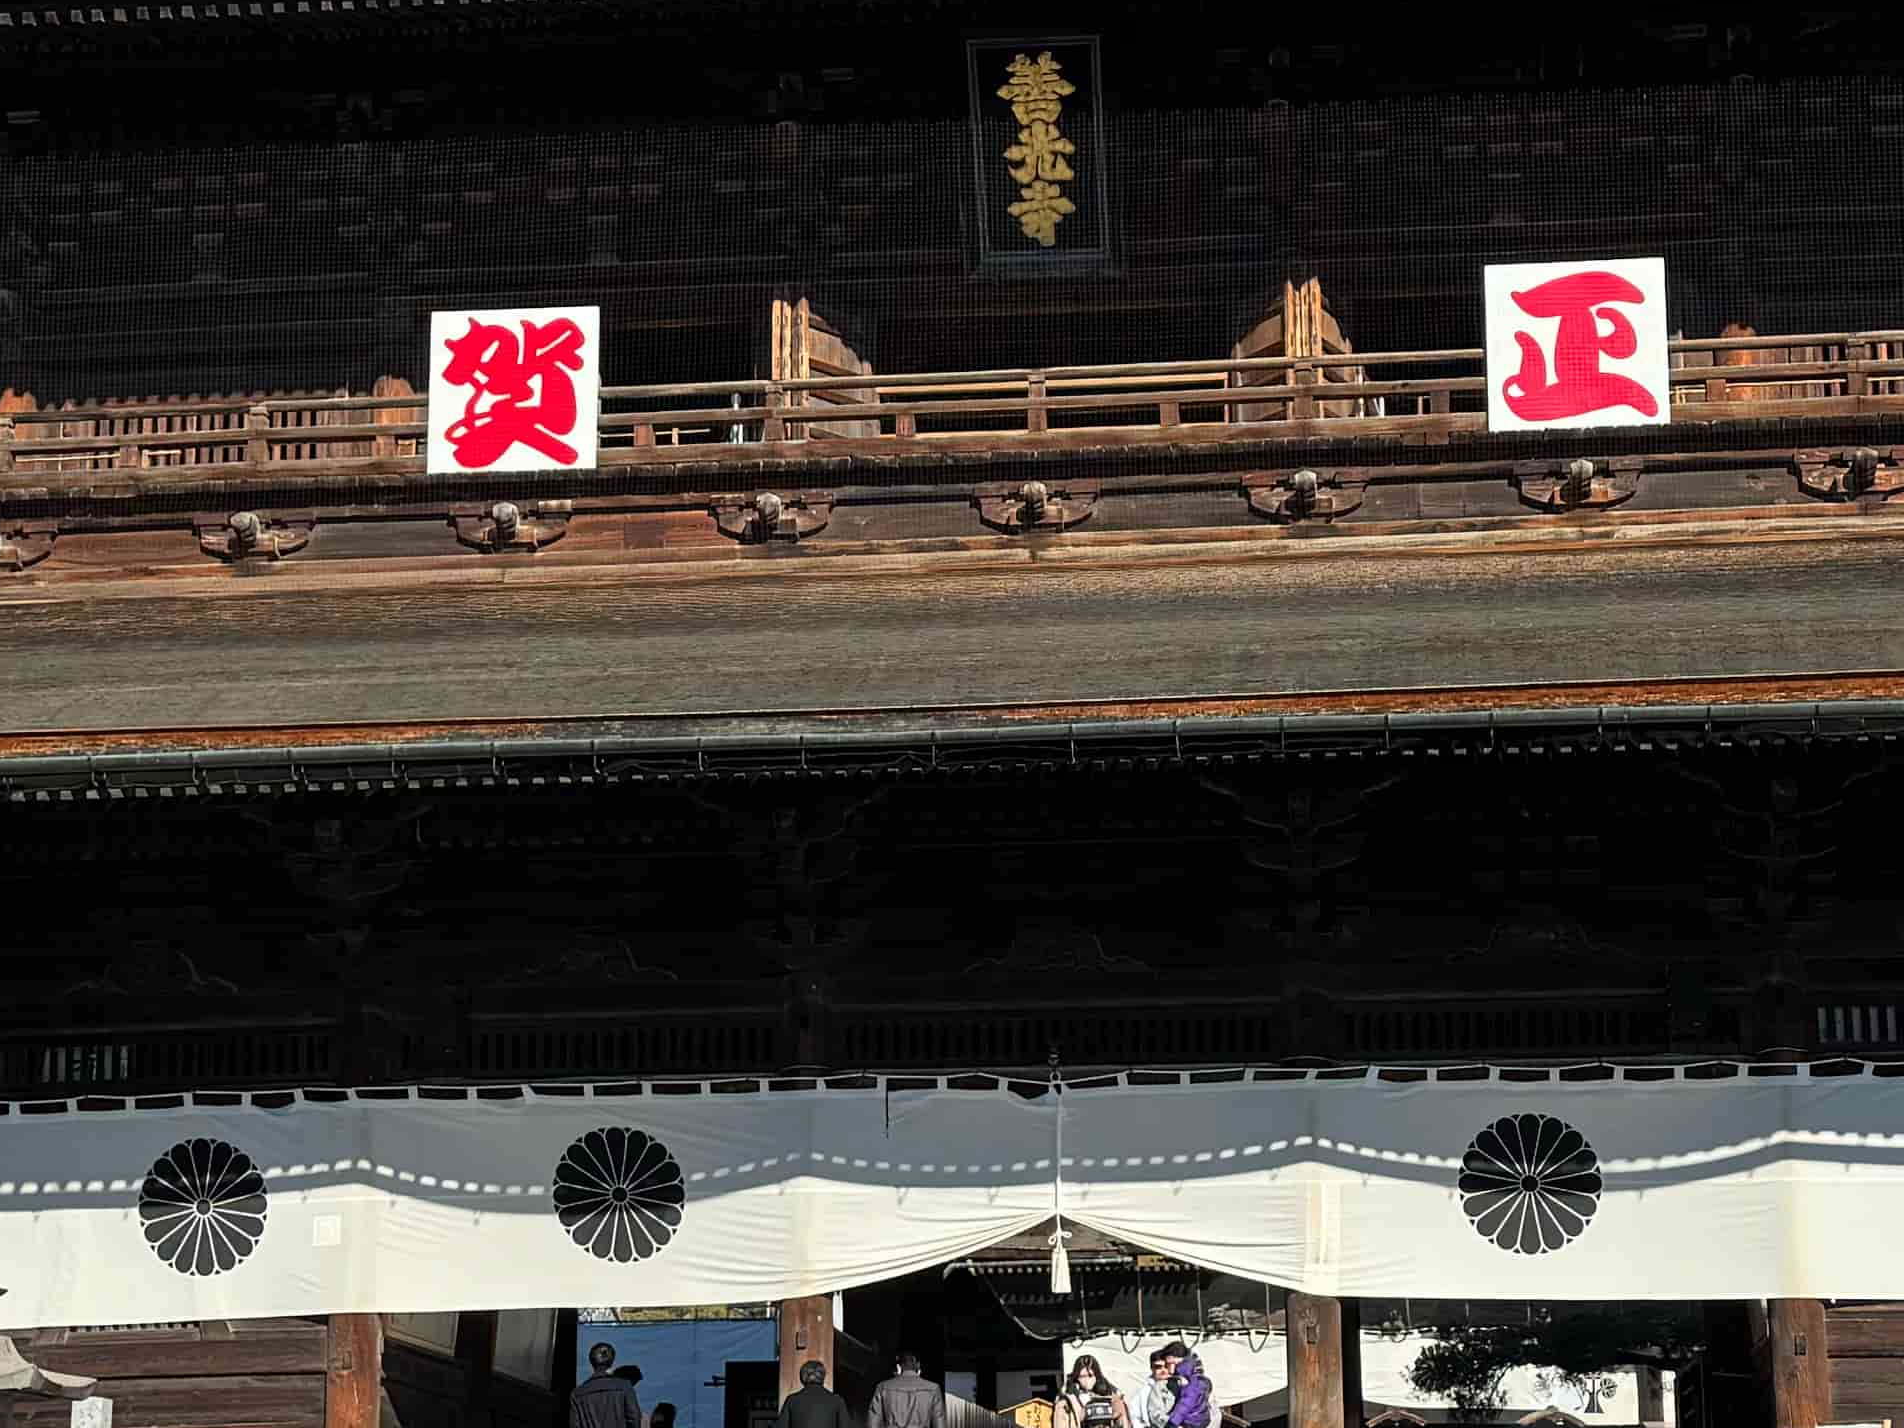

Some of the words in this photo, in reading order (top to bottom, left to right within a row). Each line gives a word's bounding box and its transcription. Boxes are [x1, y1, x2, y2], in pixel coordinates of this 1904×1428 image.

[996, 50, 1077, 247] 善光寺
[442, 317, 584, 468] 賀
[1502, 271, 1656, 422] 正
